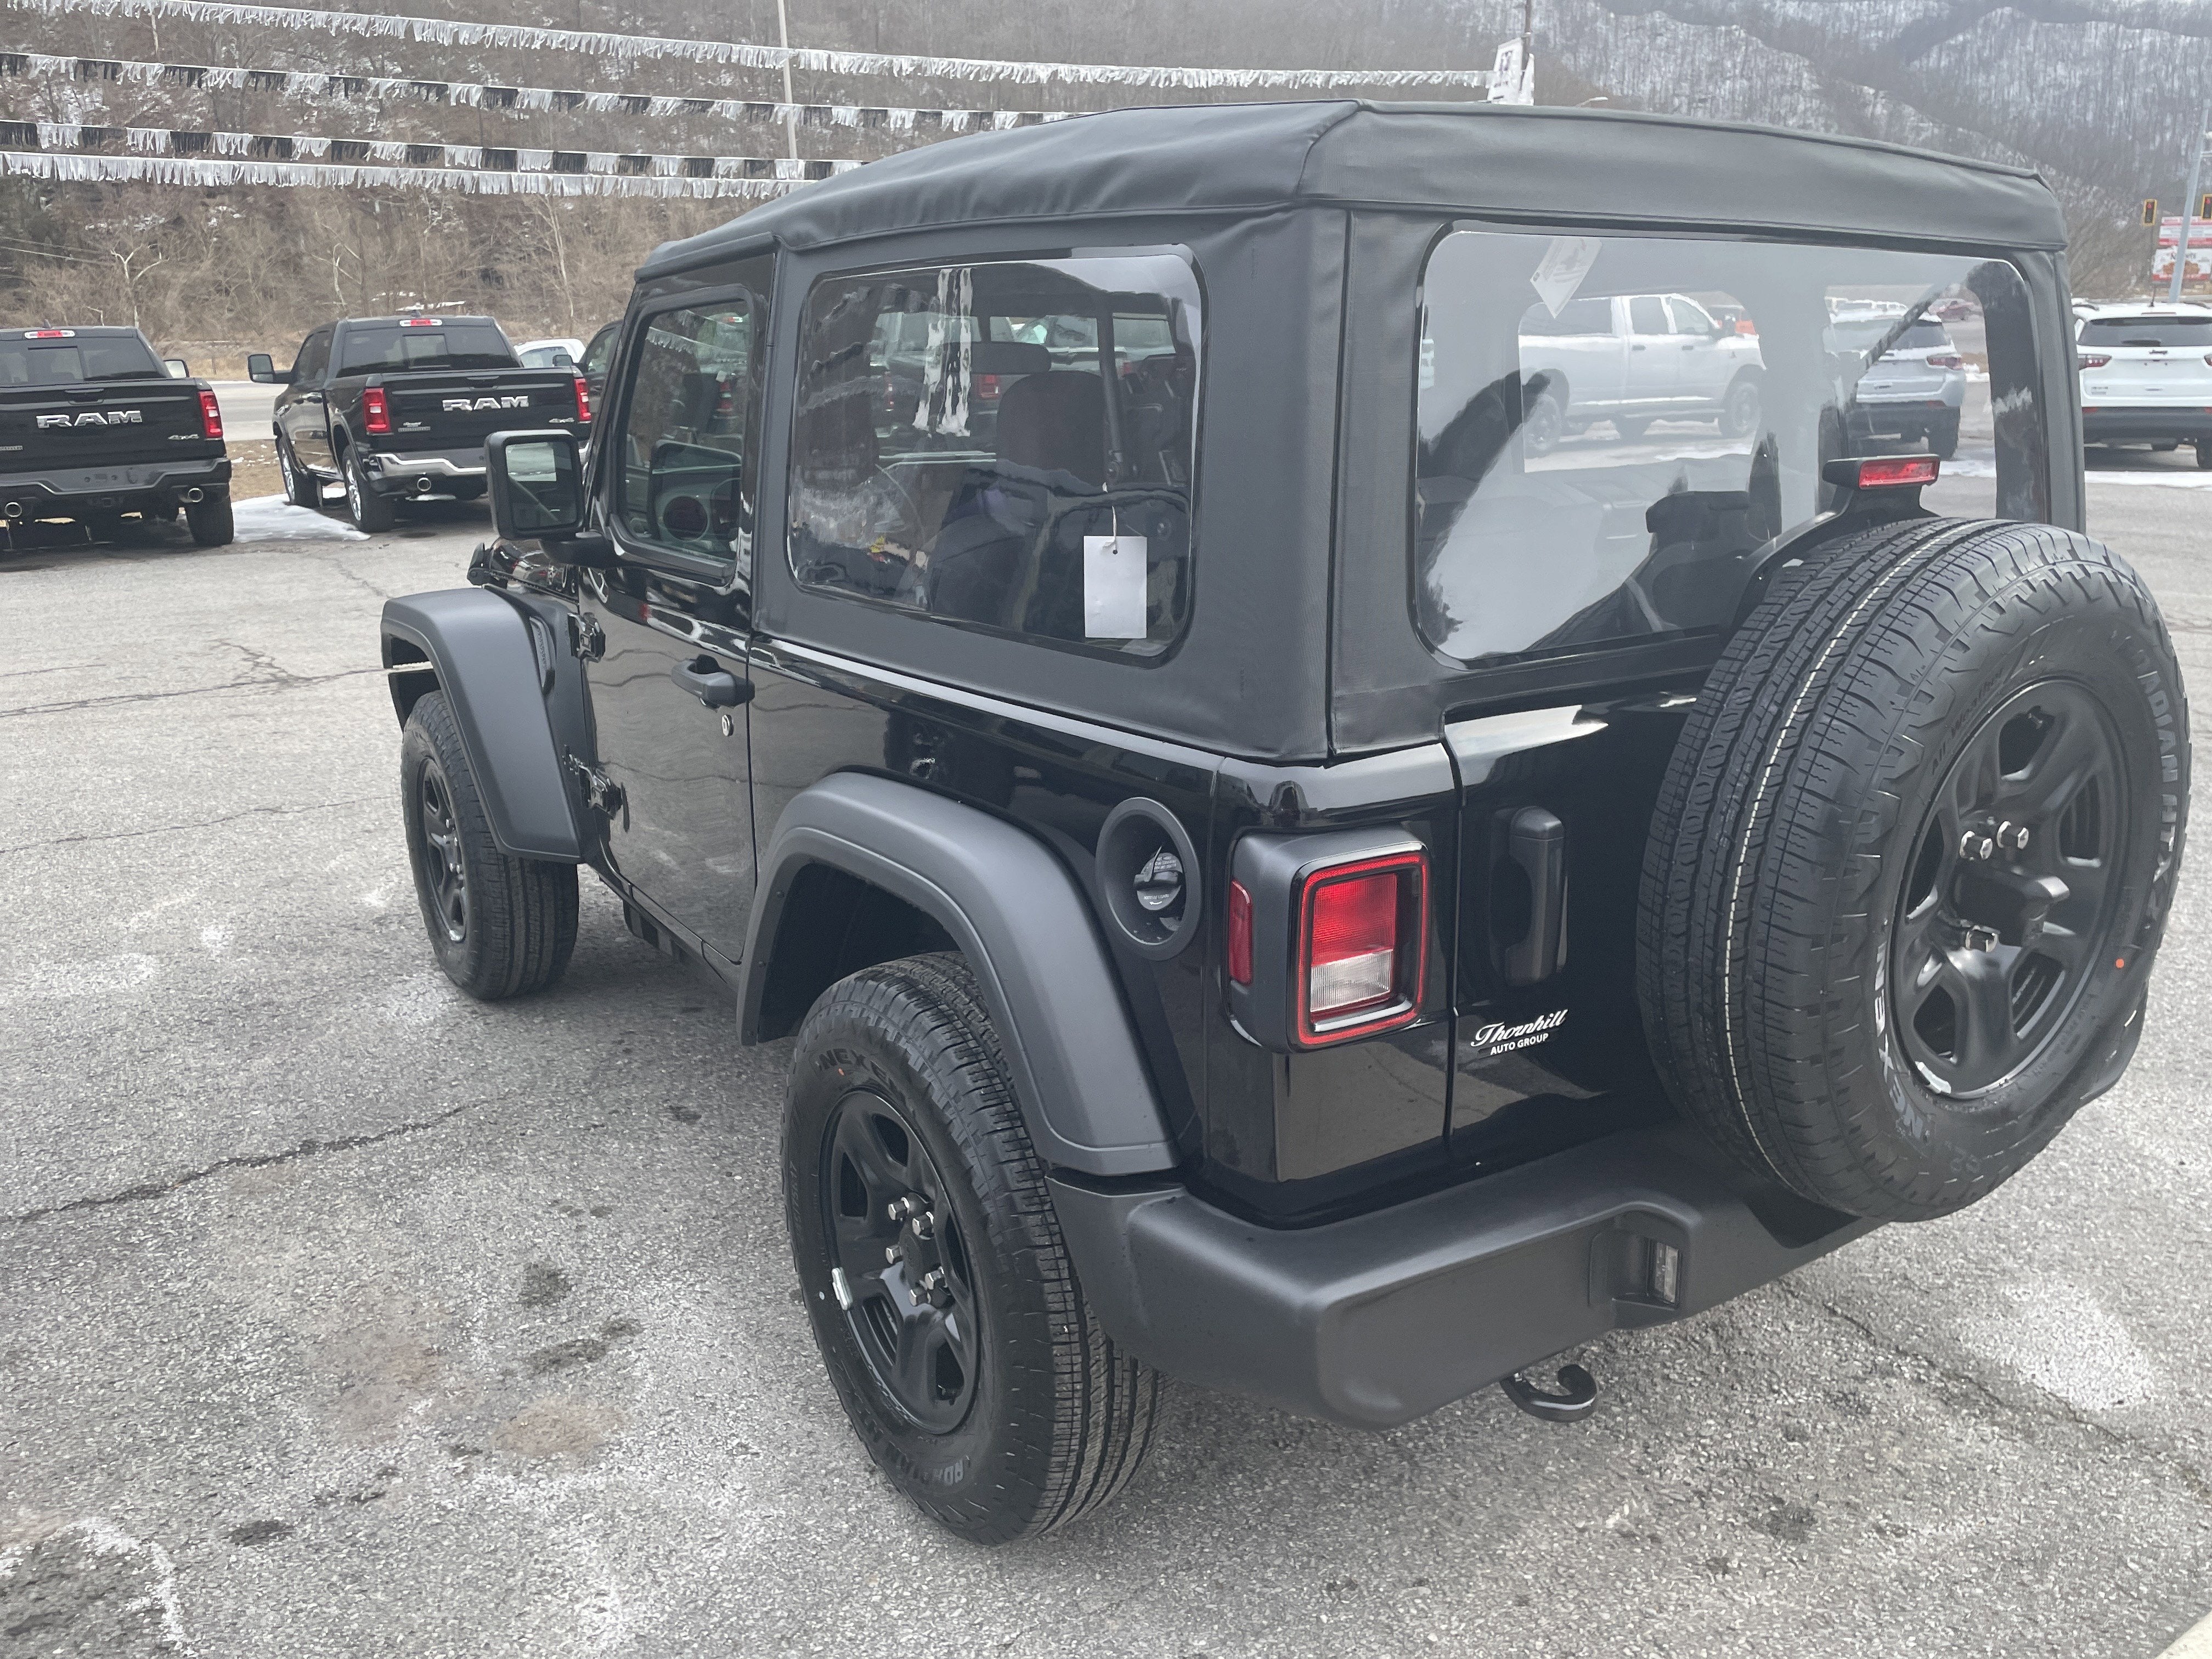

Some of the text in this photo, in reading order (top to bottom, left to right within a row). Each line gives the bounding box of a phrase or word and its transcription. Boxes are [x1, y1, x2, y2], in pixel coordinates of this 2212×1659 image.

[442, 396, 529, 411] RAM
[36, 410, 142, 428] RAM
[1471, 1009, 1568, 1047] Thornhill
[1875, 941, 1922, 1138] NEXEN
[1491, 1032, 1549, 1056] AUTO GROUP
